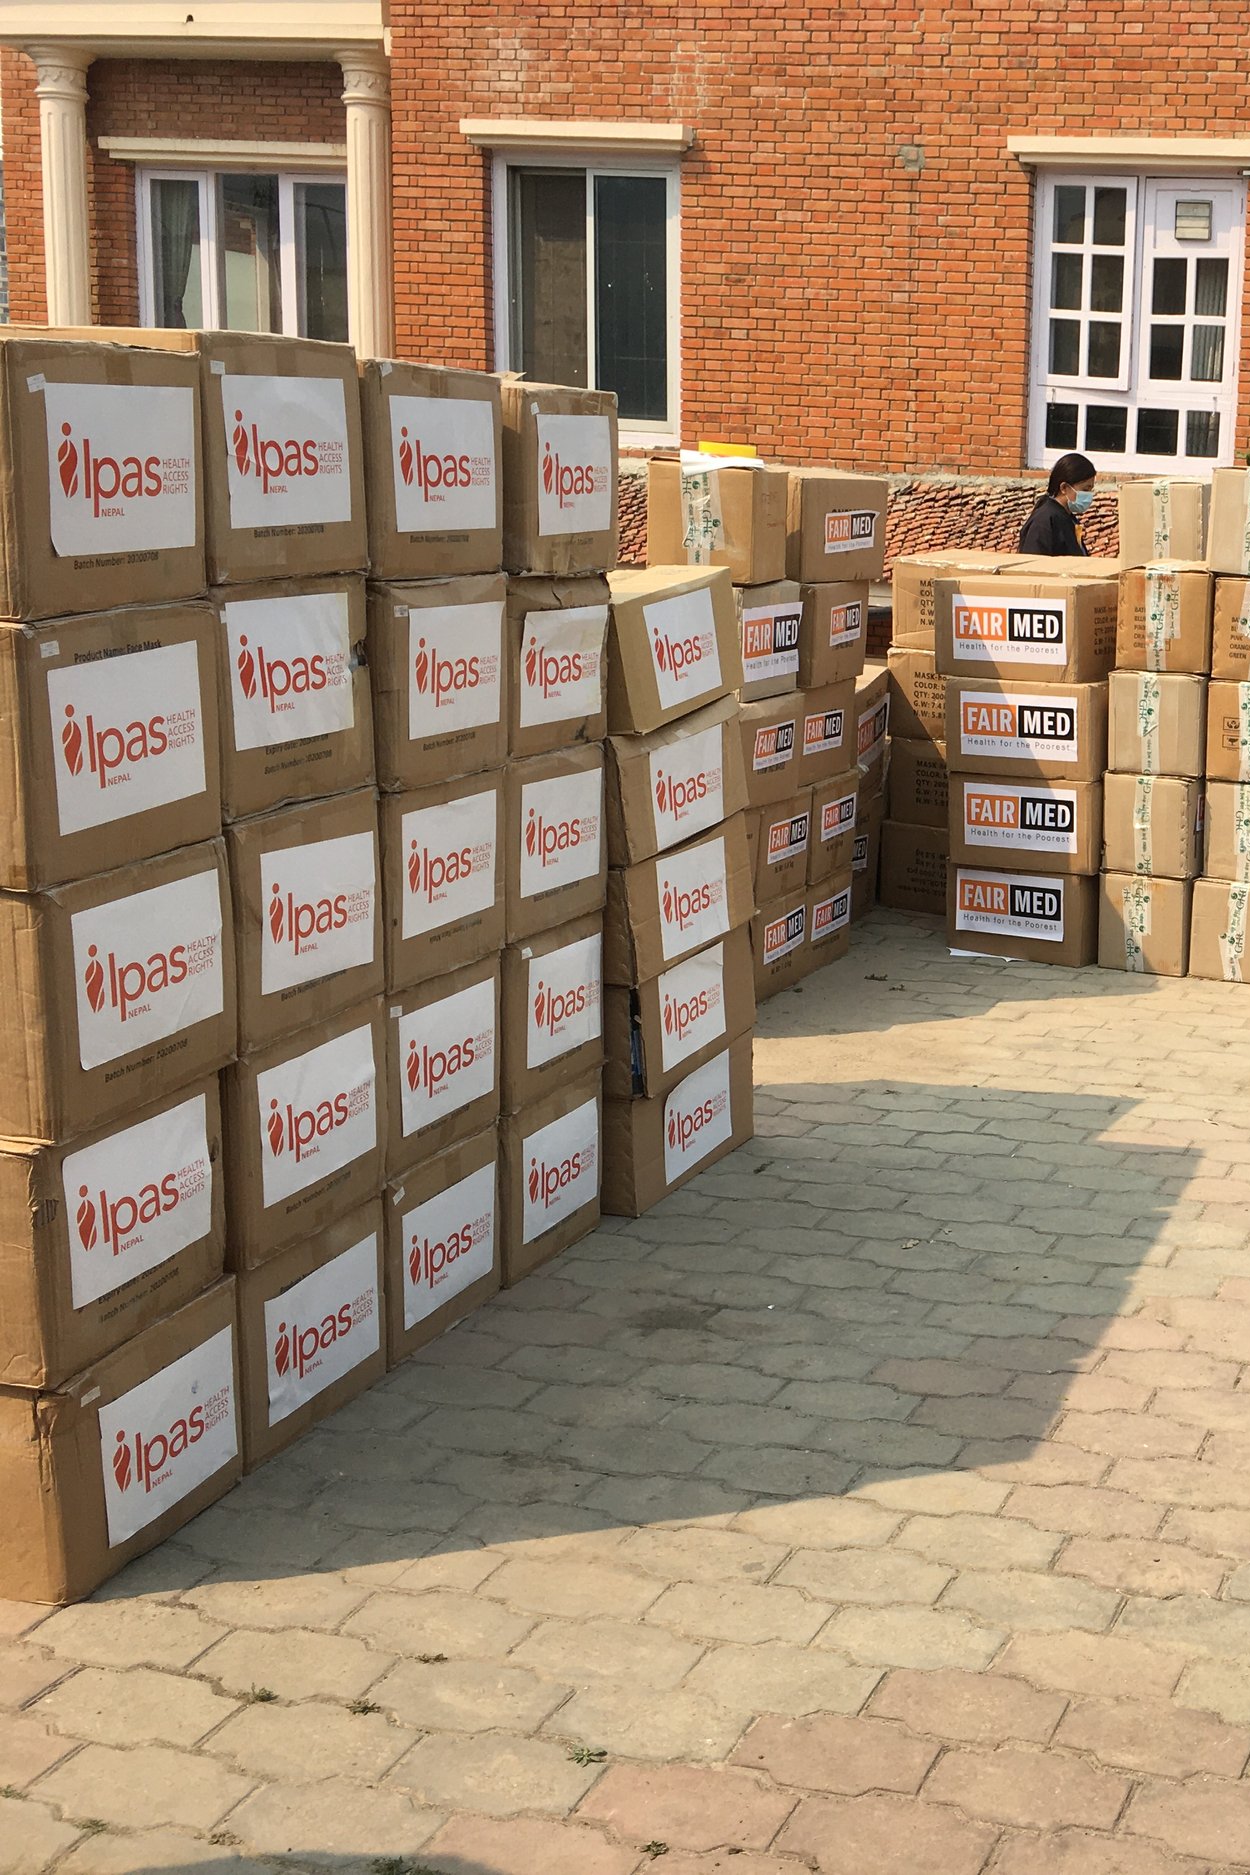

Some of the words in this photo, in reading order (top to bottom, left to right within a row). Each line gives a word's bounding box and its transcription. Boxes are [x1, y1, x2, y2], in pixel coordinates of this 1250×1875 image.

[318, 441, 343, 452] HEALTH
[162, 458, 190, 469] HEALTH
[251, 424, 319, 494] Ipas
[319, 453, 343, 463] ACCESS
[471, 457, 491, 466] HEALTH
[83, 439, 162, 518] Ipas
[163, 471, 189, 481] ACCESS
[319, 464, 342, 474] RIGHTS
[415, 439, 471, 502] Ipas
[471, 467, 490, 476] ACCESS
[162, 483, 188, 494] RIGHTS
[269, 485, 288, 494] NEPAL
[471, 477, 490, 486] RIGHTS
[555, 453, 594, 509] Ipas
[101, 507, 125, 517] NEPAL
[828, 519, 849, 539] FAIR
[852, 516, 871, 536] MED
[73, 559, 95, 570] Batch
[959, 611, 1003, 637] FAIR
[1013, 613, 1060, 639] MED
[746, 623, 771, 654] FAIR
[775, 619, 798, 648] MED
[74, 650, 103, 664] Product
[664, 634, 702, 681] Ipas
[959, 642, 987, 651] Health
[991, 643, 1003, 651] for
[1007, 644, 1020, 652] the
[1024, 645, 1059, 655] Poorest
[257, 646, 327, 713] Ipas
[431, 648, 480, 708] Ipas
[914, 681, 941, 691] COLOR:
[914, 691, 930, 699] QTY:
[275, 702, 295, 712] NEPAL
[914, 701, 930, 709] G.W:
[914, 710, 930, 718] N.W:
[166, 709, 195, 725] HEALTH
[967, 707, 1012, 733] FAIR
[1023, 710, 1071, 736] MED
[168, 721, 195, 737] ACCESS
[807, 720, 823, 741] FAIR
[825, 716, 841, 736] MED
[168, 734, 195, 750] RIGHTS
[757, 733, 776, 755] FAIR
[777, 727, 793, 749] MED
[967, 737, 996, 746] Health
[1000, 740, 1012, 748] for
[1017, 741, 1030, 749] the
[1035, 741, 1070, 751] Poorest
[86, 714, 167, 789] Ipas
[107, 772, 132, 786] NEPAL
[667, 772, 707, 821] Ipas
[825, 806, 840, 827] FAIR
[970, 798, 1015, 824] FAIR
[1025, 802, 1071, 828] MED
[538, 816, 581, 868] Ipas
[771, 828, 790, 849] FAIR
[790, 820, 807, 842] MED
[970, 828, 998, 838] Health
[1002, 830, 1014, 839] for
[1018, 832, 1032, 840] the
[1036, 833, 1070, 844] Poorest
[472, 841, 492, 854] HEALTH
[472, 852, 491, 865] ACCESS
[423, 847, 473, 904] Ipas
[348, 890, 370, 902] HEALTH
[964, 883, 1005, 910] FAIR
[1014, 889, 1057, 916] MED
[348, 901, 369, 913] ACCESS
[674, 884, 711, 931] Ipas
[816, 904, 832, 927] FAIR
[287, 892, 348, 956] Ipas
[348, 911, 369, 924] RIGHTS
[963, 913, 990, 923] Health
[993, 916, 1006, 925] for
[1008, 918, 1021, 927] the
[1025, 921, 1057, 931] Poorest
[767, 925, 786, 949] FAIR
[788, 913, 803, 938] MED
[187, 933, 217, 953] HEALTH
[299, 942, 319, 954] NEPAL
[188, 946, 214, 965] ACCESS
[188, 960, 214, 977] RIGHTS
[108, 945, 188, 1022] Ipas
[127, 1004, 152, 1019] NEPAL
[546, 984, 585, 1037] Ipas
[674, 990, 708, 1041] Ipas
[475, 1027, 493, 1043] HEALTH
[475, 1039, 493, 1052] ACCESS
[423, 1037, 475, 1098] Ipas
[348, 1079, 371, 1098] HEALTH
[348, 1092, 370, 1109] ACCESS
[348, 1102, 370, 1119] RIGHTS
[286, 1092, 348, 1164] Ipas
[677, 1099, 713, 1152] Ipas
[301, 1144, 321, 1160] NEPAL
[177, 1157, 205, 1181] HEALTH
[179, 1169, 205, 1191] ACCESS
[541, 1152, 581, 1209] Ipas
[180, 1181, 205, 1202] RIGHTS
[99, 1173, 180, 1257] Ipas
[472, 1212, 491, 1228] HEALTH
[472, 1221, 491, 1237] ACCESS
[120, 1235, 144, 1252] NEPAL
[424, 1223, 474, 1289] Ipas
[352, 1288, 374, 1308] HEALTH
[352, 1298, 374, 1317] ACCESS
[352, 1309, 373, 1327] RIGHTS
[292, 1303, 352, 1379] Ipas
[304, 1359, 323, 1376] NEPAL
[204, 1385, 230, 1411] HEALTH
[205, 1397, 229, 1420] ACCESS
[205, 1409, 229, 1432] RIGHTS
[135, 1405, 205, 1494] Ipas
[152, 1469, 174, 1489] NEPAL
